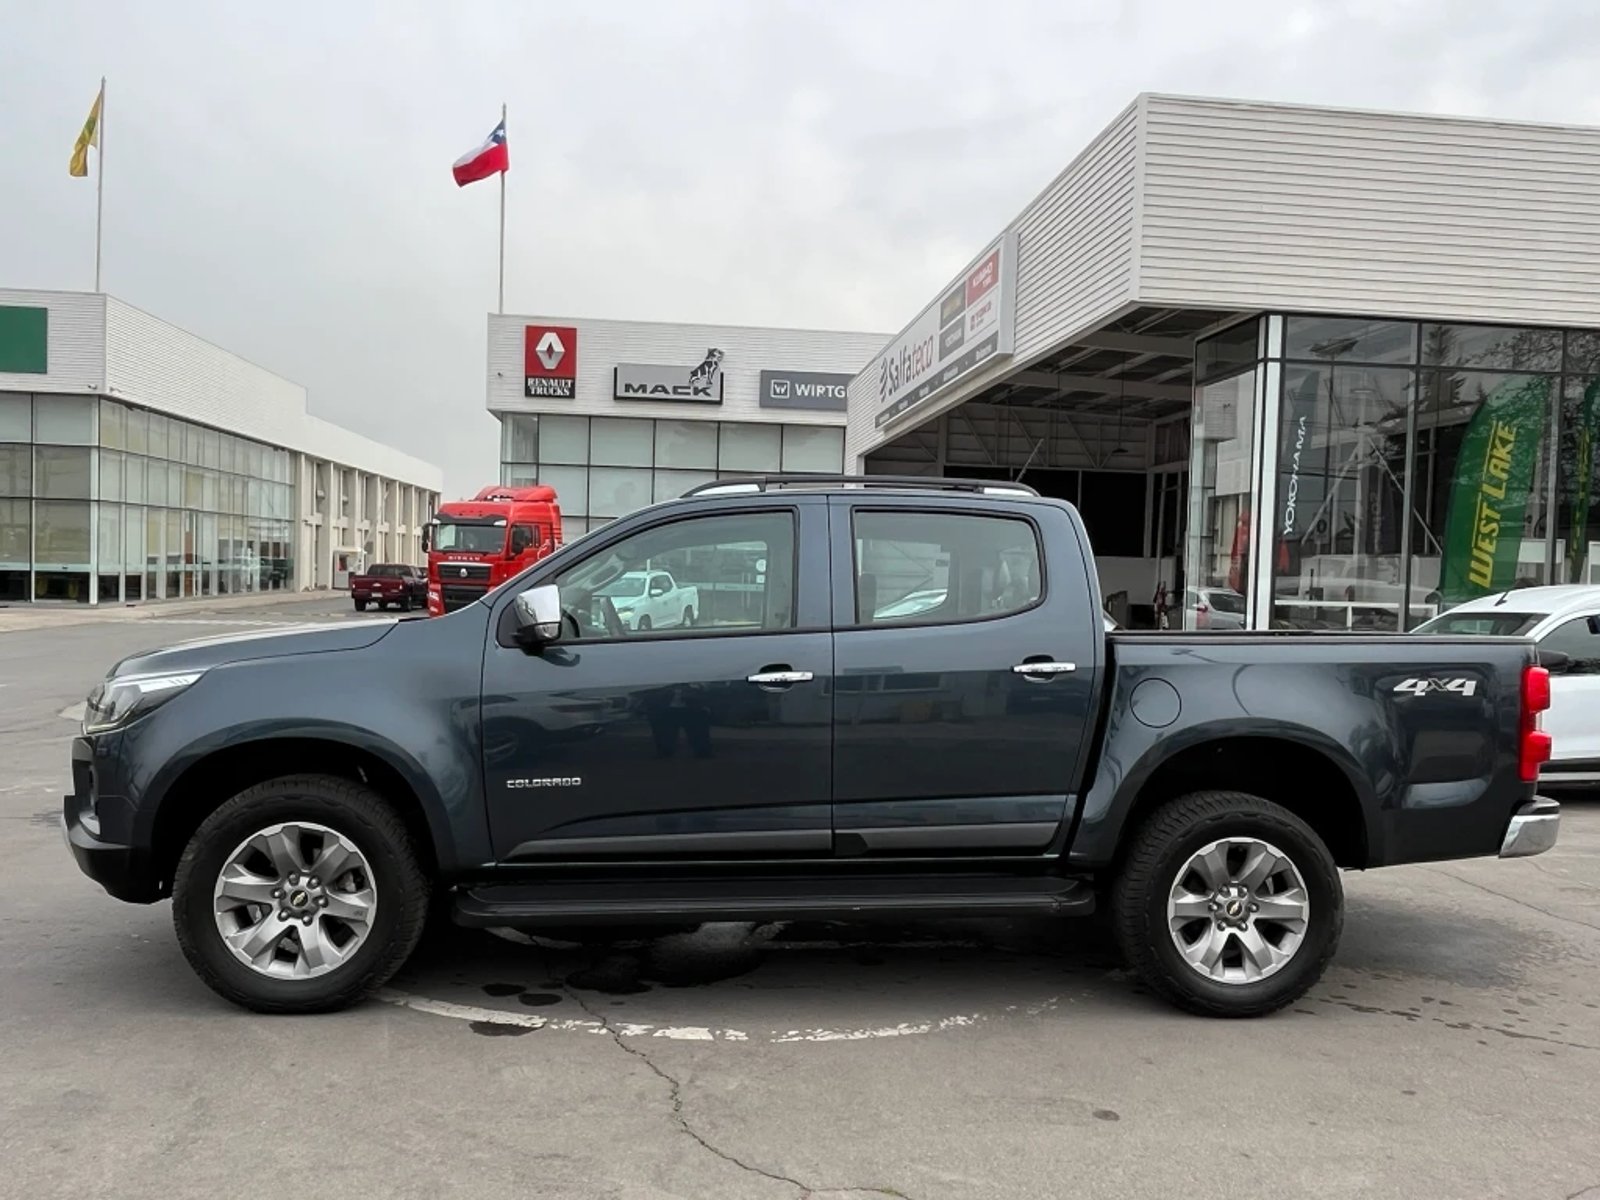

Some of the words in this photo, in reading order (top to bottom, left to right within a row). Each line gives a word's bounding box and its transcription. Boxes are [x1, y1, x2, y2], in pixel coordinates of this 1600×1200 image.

[527, 377, 573, 388] RENAULT
[530, 386, 570, 396] TRUCKS
[624, 383, 712, 397] MACK
[795, 383, 848, 398] WIRTG
[1483, 421, 1517, 500] LAKE
[1283, 416, 1307, 535] YOKOHAMA
[1469, 502, 1501, 588] WEST
[506, 777, 581, 788] COLORADO
